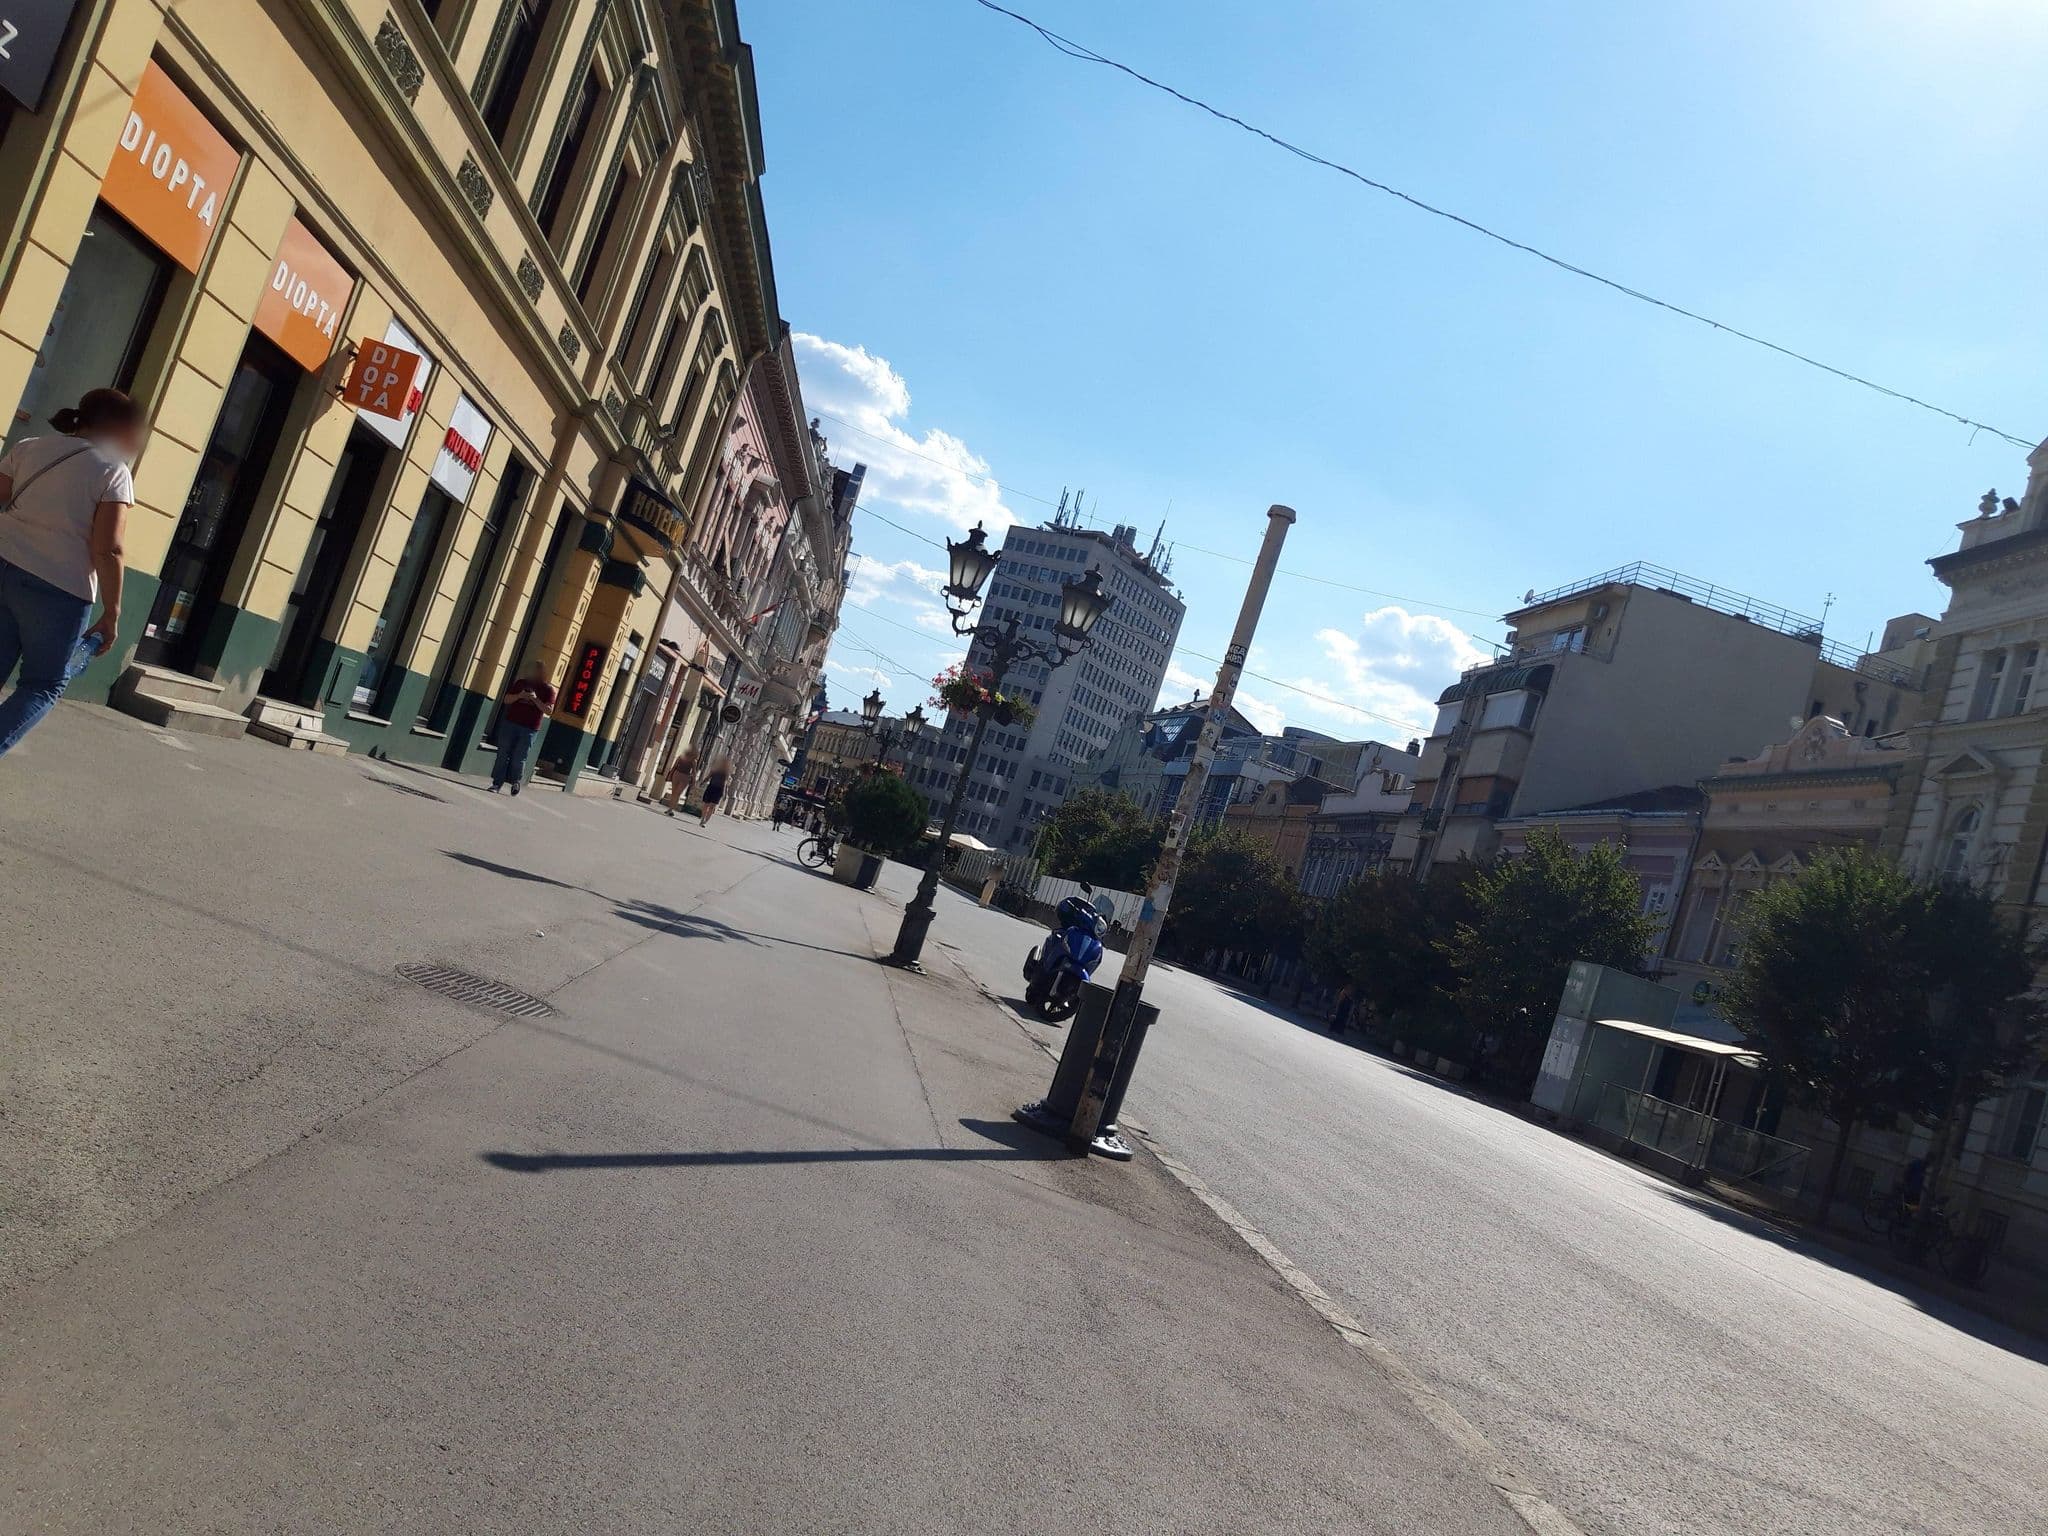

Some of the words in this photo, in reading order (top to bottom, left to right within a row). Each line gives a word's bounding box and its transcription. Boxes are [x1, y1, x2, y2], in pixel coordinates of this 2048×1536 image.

[120, 110, 216, 227] DIOPTA
[272, 260, 336, 339] DIOPTA
[363, 366, 399, 389] OP
[371, 346, 400, 369] DI
[359, 384, 388, 410] TA
[571, 648, 598, 713] PROMET
